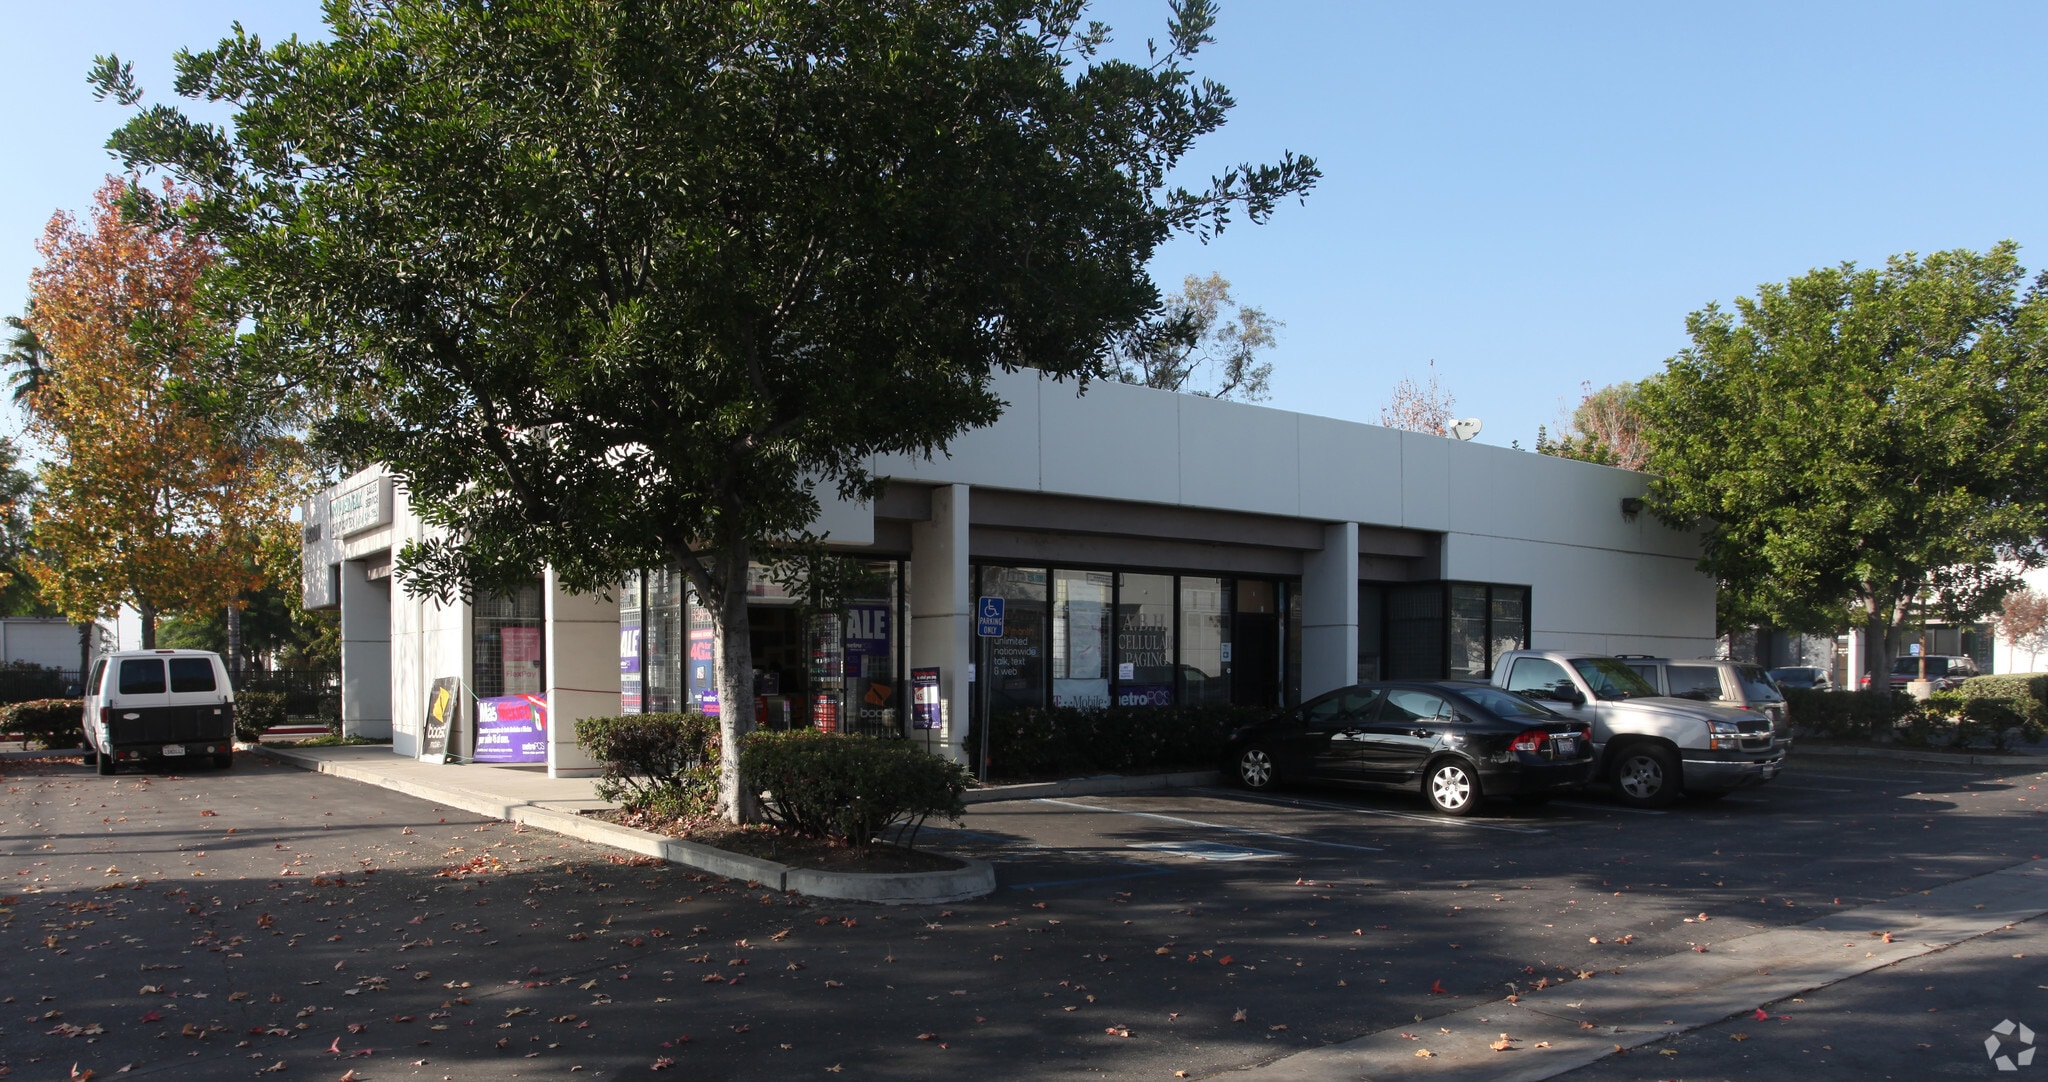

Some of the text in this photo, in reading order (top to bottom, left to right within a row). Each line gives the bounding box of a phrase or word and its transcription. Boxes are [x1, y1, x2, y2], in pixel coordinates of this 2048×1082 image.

[847, 609, 886, 640] ALE
[980, 617, 1002, 625] PARKING
[983, 626, 997, 634] ONLY
[620, 629, 640, 658] ALE
[993, 637, 1028, 646] unlimited
[1118, 634, 1174, 650] CELLULAR
[690, 642, 705, 661] 4G
[993, 647, 1037, 656] nationwide
[993, 657, 1026, 666] talk, text
[1126, 652, 1168, 668] PAGING
[1000, 667, 1018, 676] web
[1073, 695, 1104, 708] Mobile
[479, 702, 498, 722] Más
[860, 707, 896, 718] boost
[427, 723, 447, 739] boost
[521, 741, 545, 751] metroPCS
